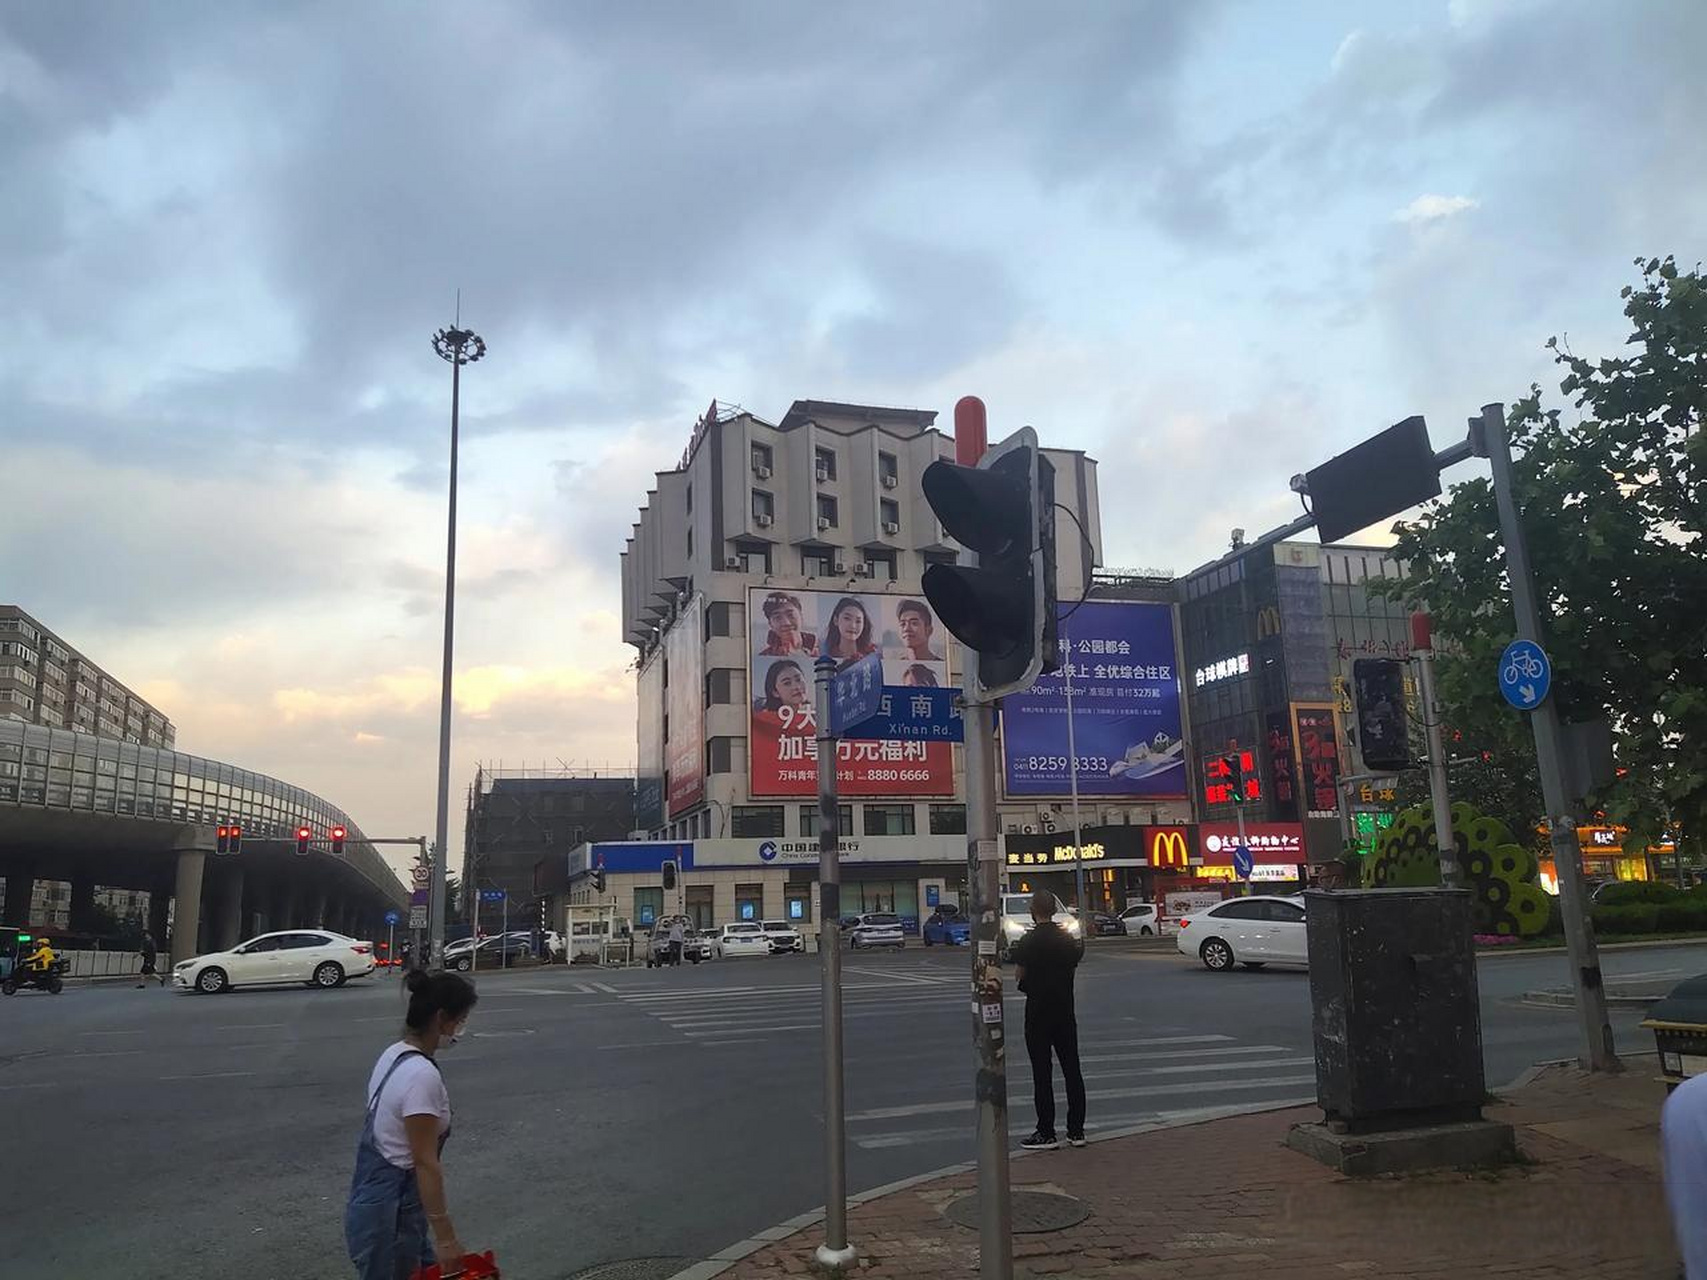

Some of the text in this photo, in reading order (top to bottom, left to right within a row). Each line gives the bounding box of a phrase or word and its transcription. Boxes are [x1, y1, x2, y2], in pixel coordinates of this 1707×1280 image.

[1093, 664, 1172, 680] 全优综合住区
[933, 725, 953, 735] Rd.
[1029, 756, 1067, 771] 8259
[777, 770, 854, 781] 万科青年计划
[867, 770, 898, 781] 8880
[899, 770, 930, 781] 6666
[781, 842, 860, 852] 中国建行
[1008, 853, 1048, 864] 麦当劳
